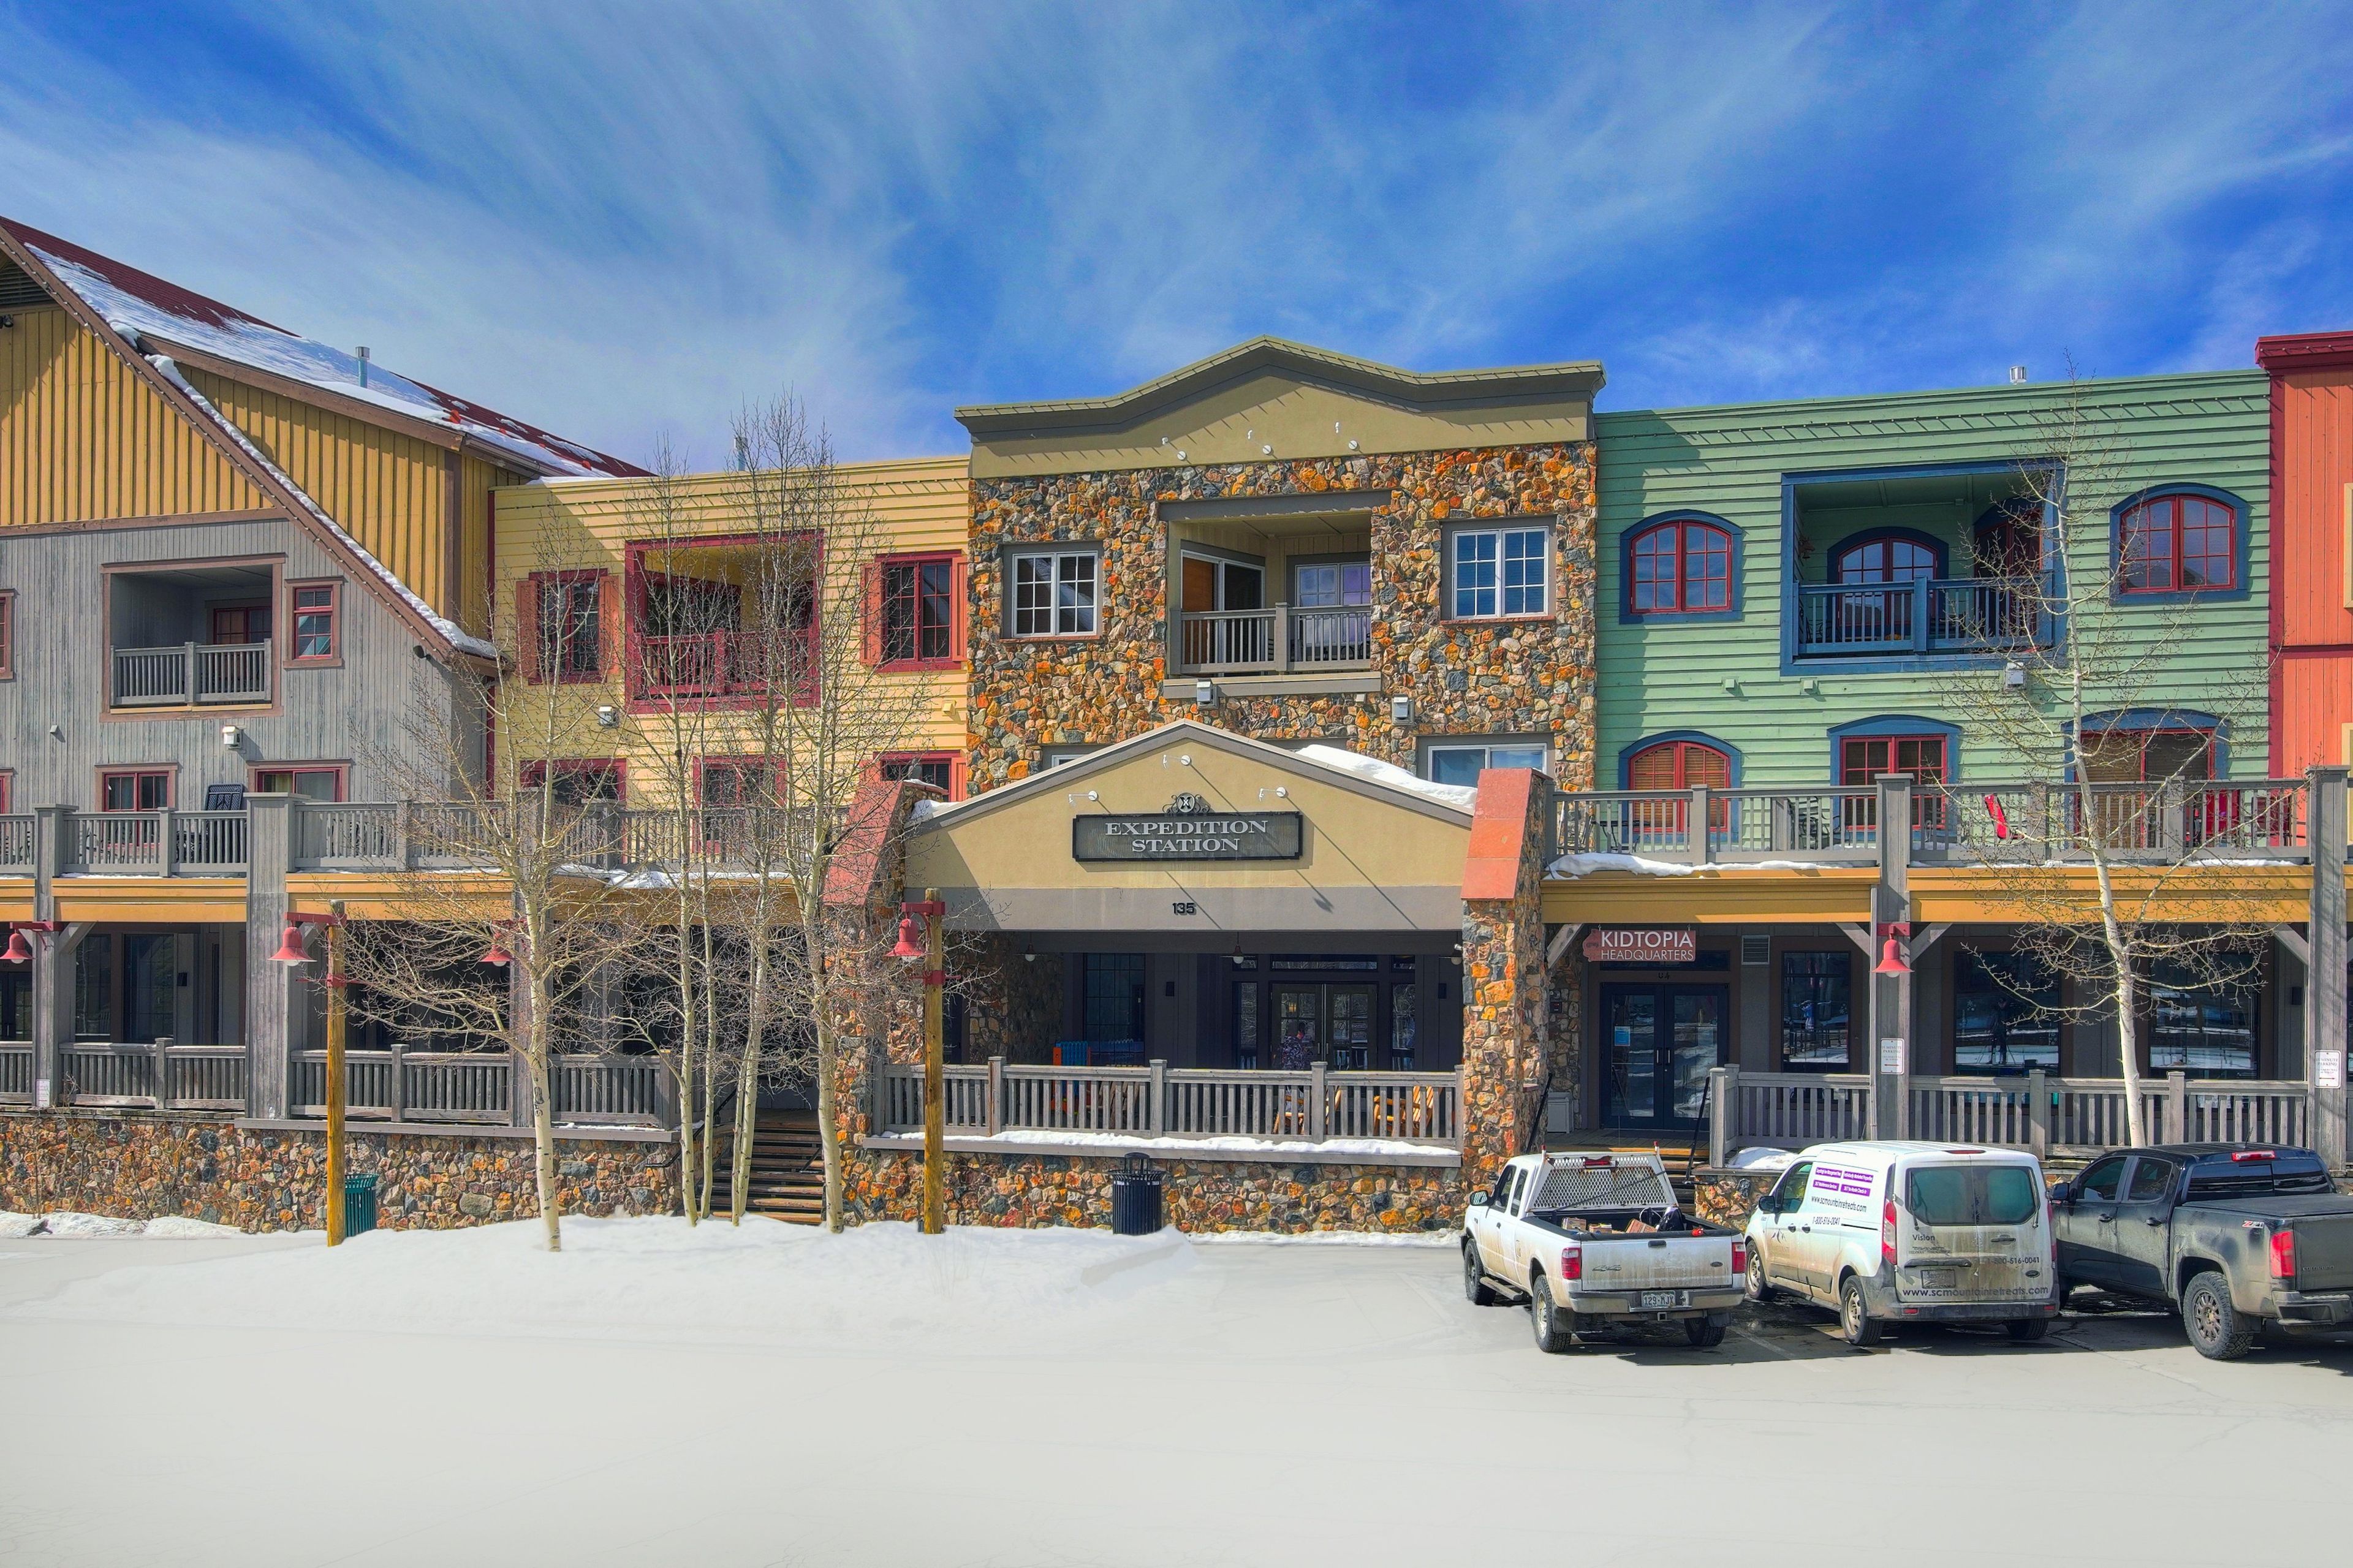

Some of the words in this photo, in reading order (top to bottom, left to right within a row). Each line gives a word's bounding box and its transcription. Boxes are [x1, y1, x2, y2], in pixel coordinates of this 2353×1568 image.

[1105, 820, 1268, 835] EXPEDITION
[1132, 838, 1240, 852] STATION
[1172, 902, 1196, 915] 135
[1601, 931, 1693, 947] KIDTOPIA
[1601, 950, 1694, 960] HEADQUARTERS
[1903, 1287, 2049, 1298] www.scmountainretreats.com
